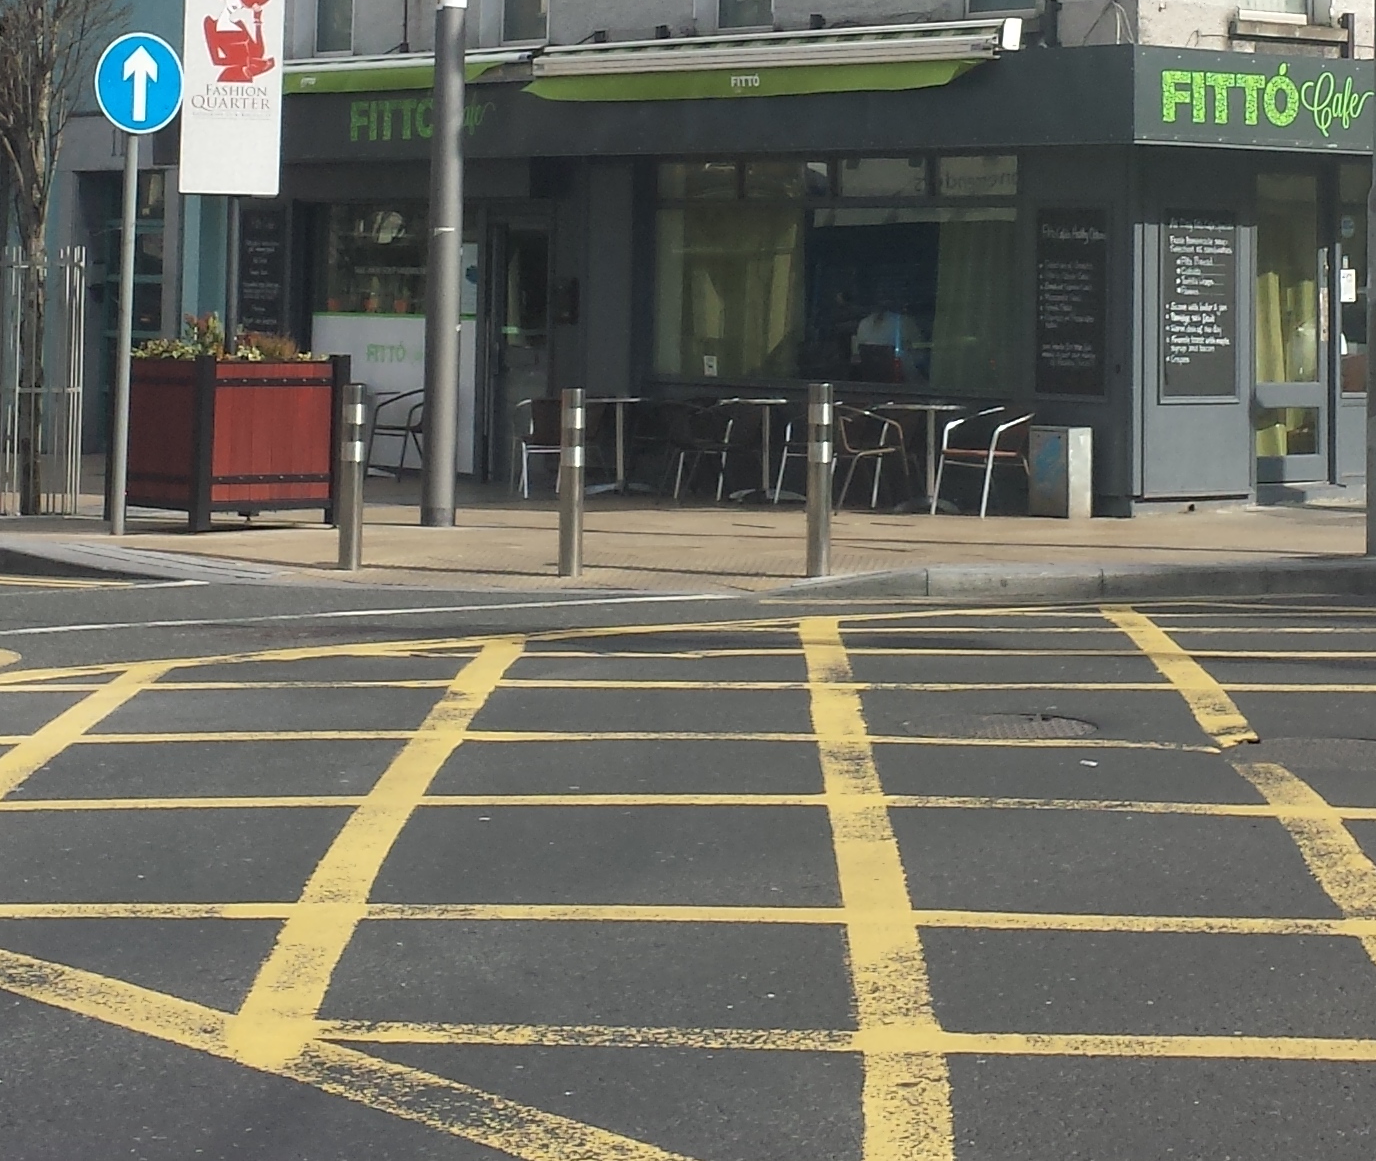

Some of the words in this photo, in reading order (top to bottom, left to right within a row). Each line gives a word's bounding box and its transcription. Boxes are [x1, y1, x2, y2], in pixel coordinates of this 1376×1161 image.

[206, 83, 267, 97] FASHION
[191, 94, 270, 111] QUARTER
[1161, 62, 1300, 127] FITTÓ
[1300, 71, 1375, 138] Cafe
